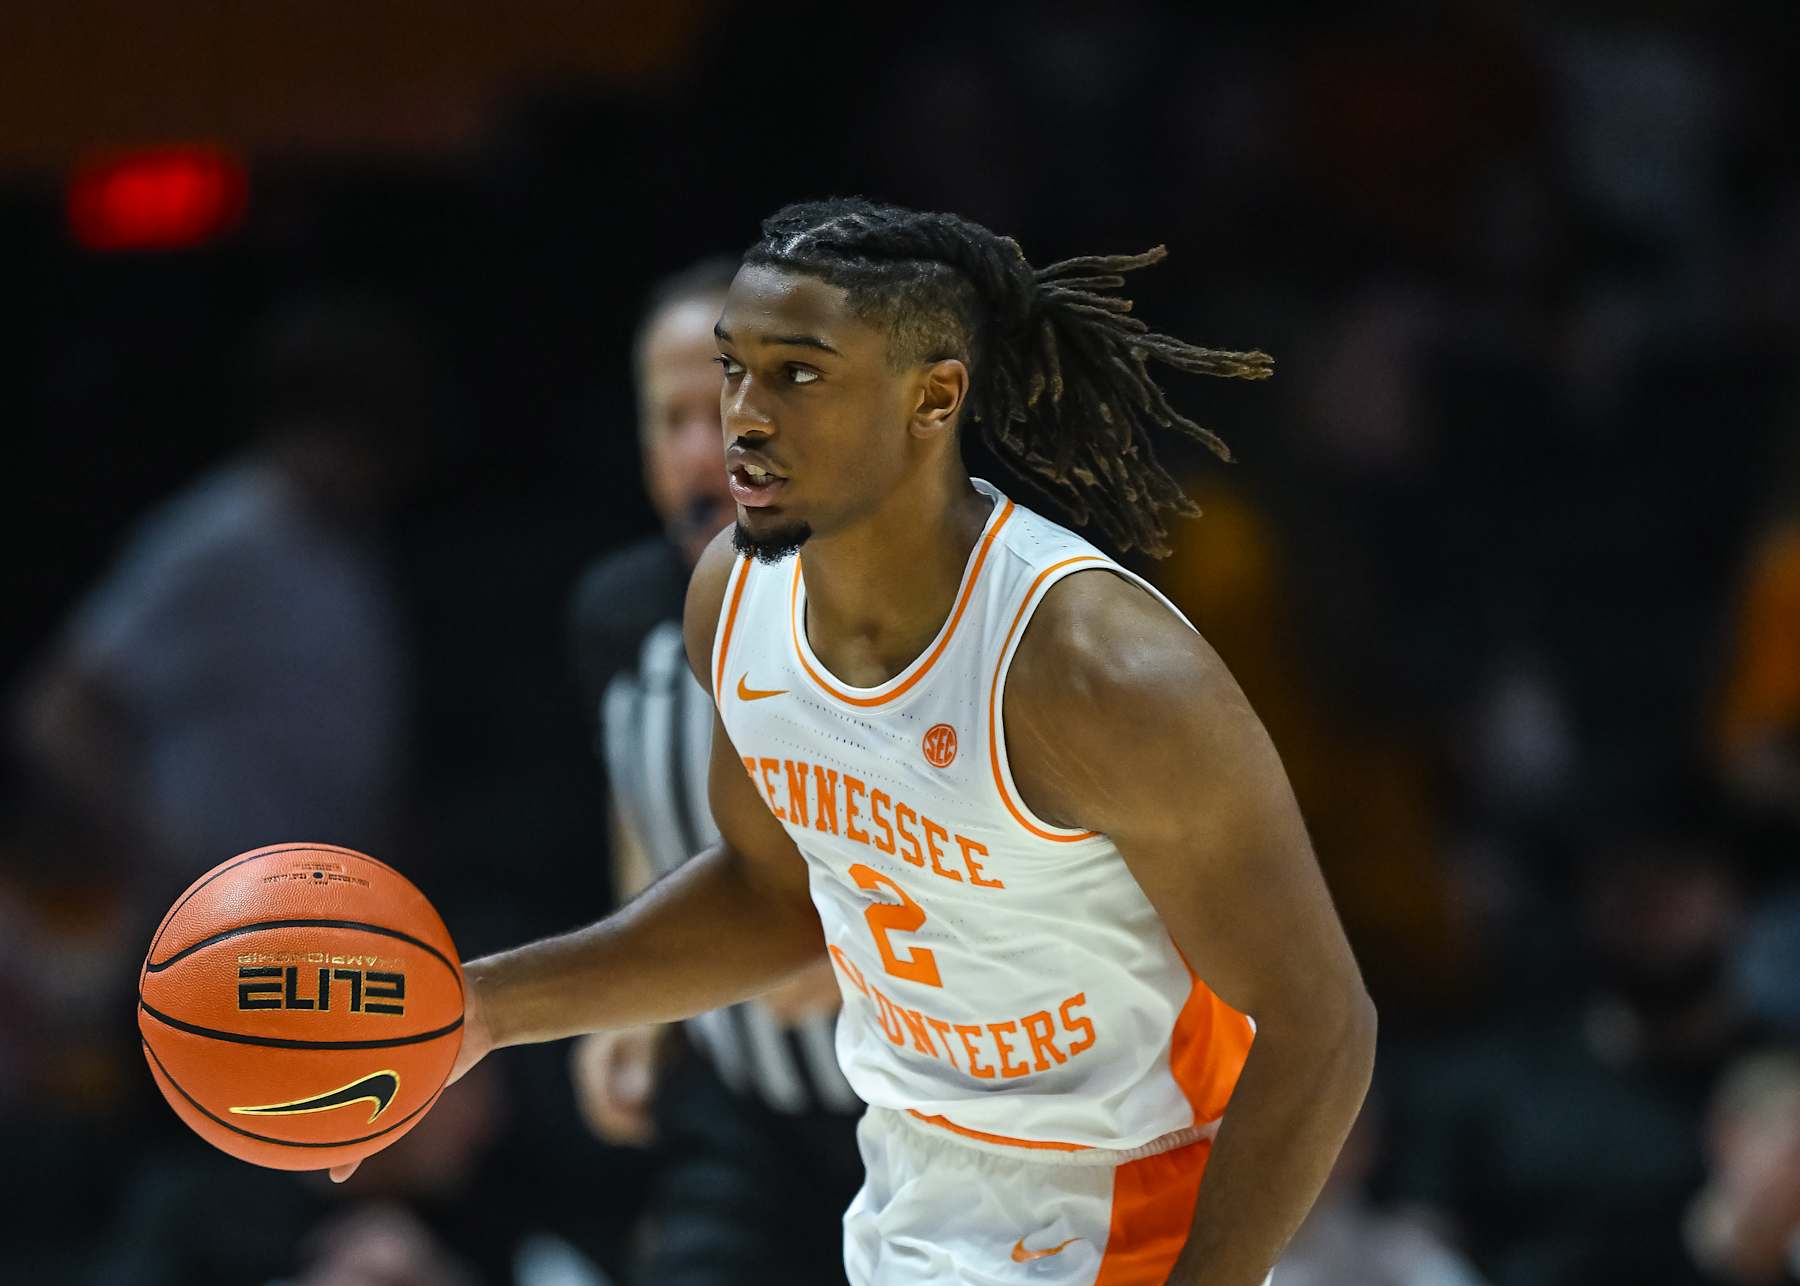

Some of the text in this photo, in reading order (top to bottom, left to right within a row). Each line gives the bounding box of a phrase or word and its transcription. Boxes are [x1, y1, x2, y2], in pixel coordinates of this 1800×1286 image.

[923, 724, 957, 767] SEC
[848, 863, 943, 988] 2
[237, 966, 406, 1016] ELITE
